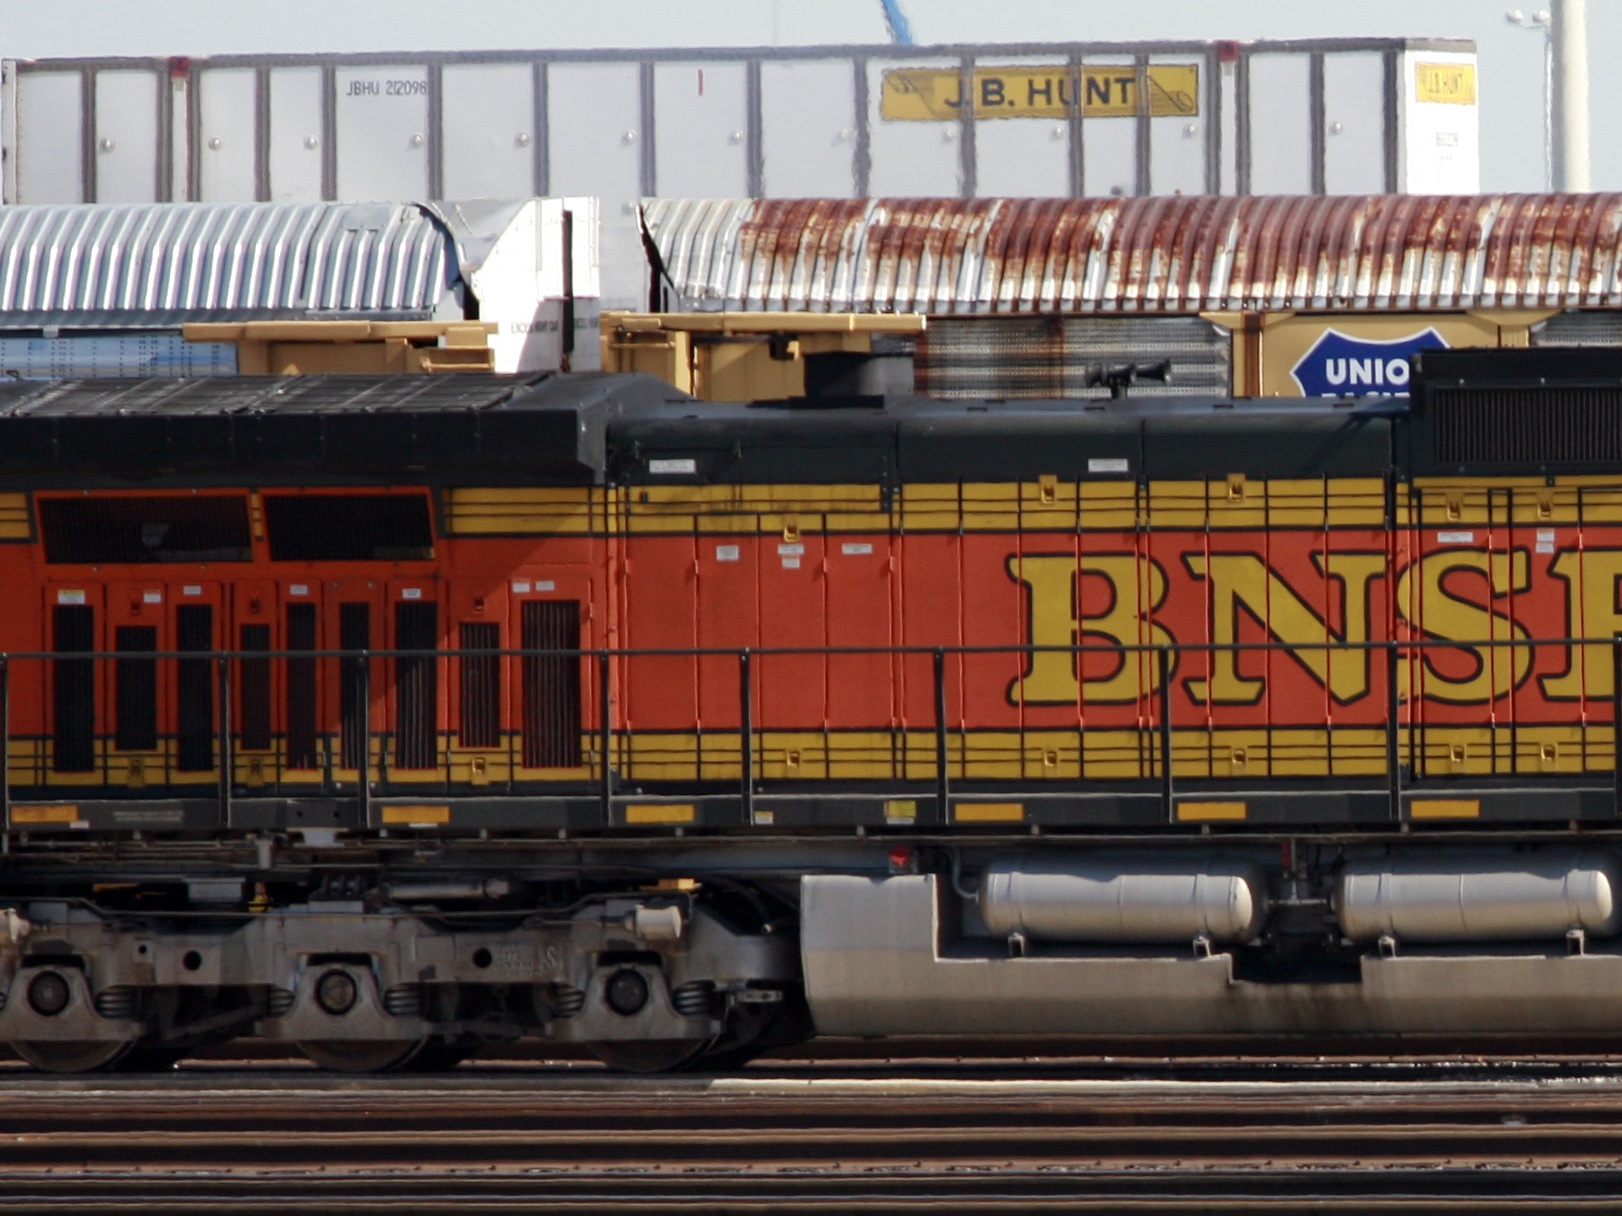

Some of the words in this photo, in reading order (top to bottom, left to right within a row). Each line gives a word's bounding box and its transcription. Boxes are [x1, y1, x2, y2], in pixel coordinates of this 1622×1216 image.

[346, 80, 380, 97] JBHU
[1027, 76, 1136, 106] HUNT
[1325, 357, 1410, 386] UNIO
